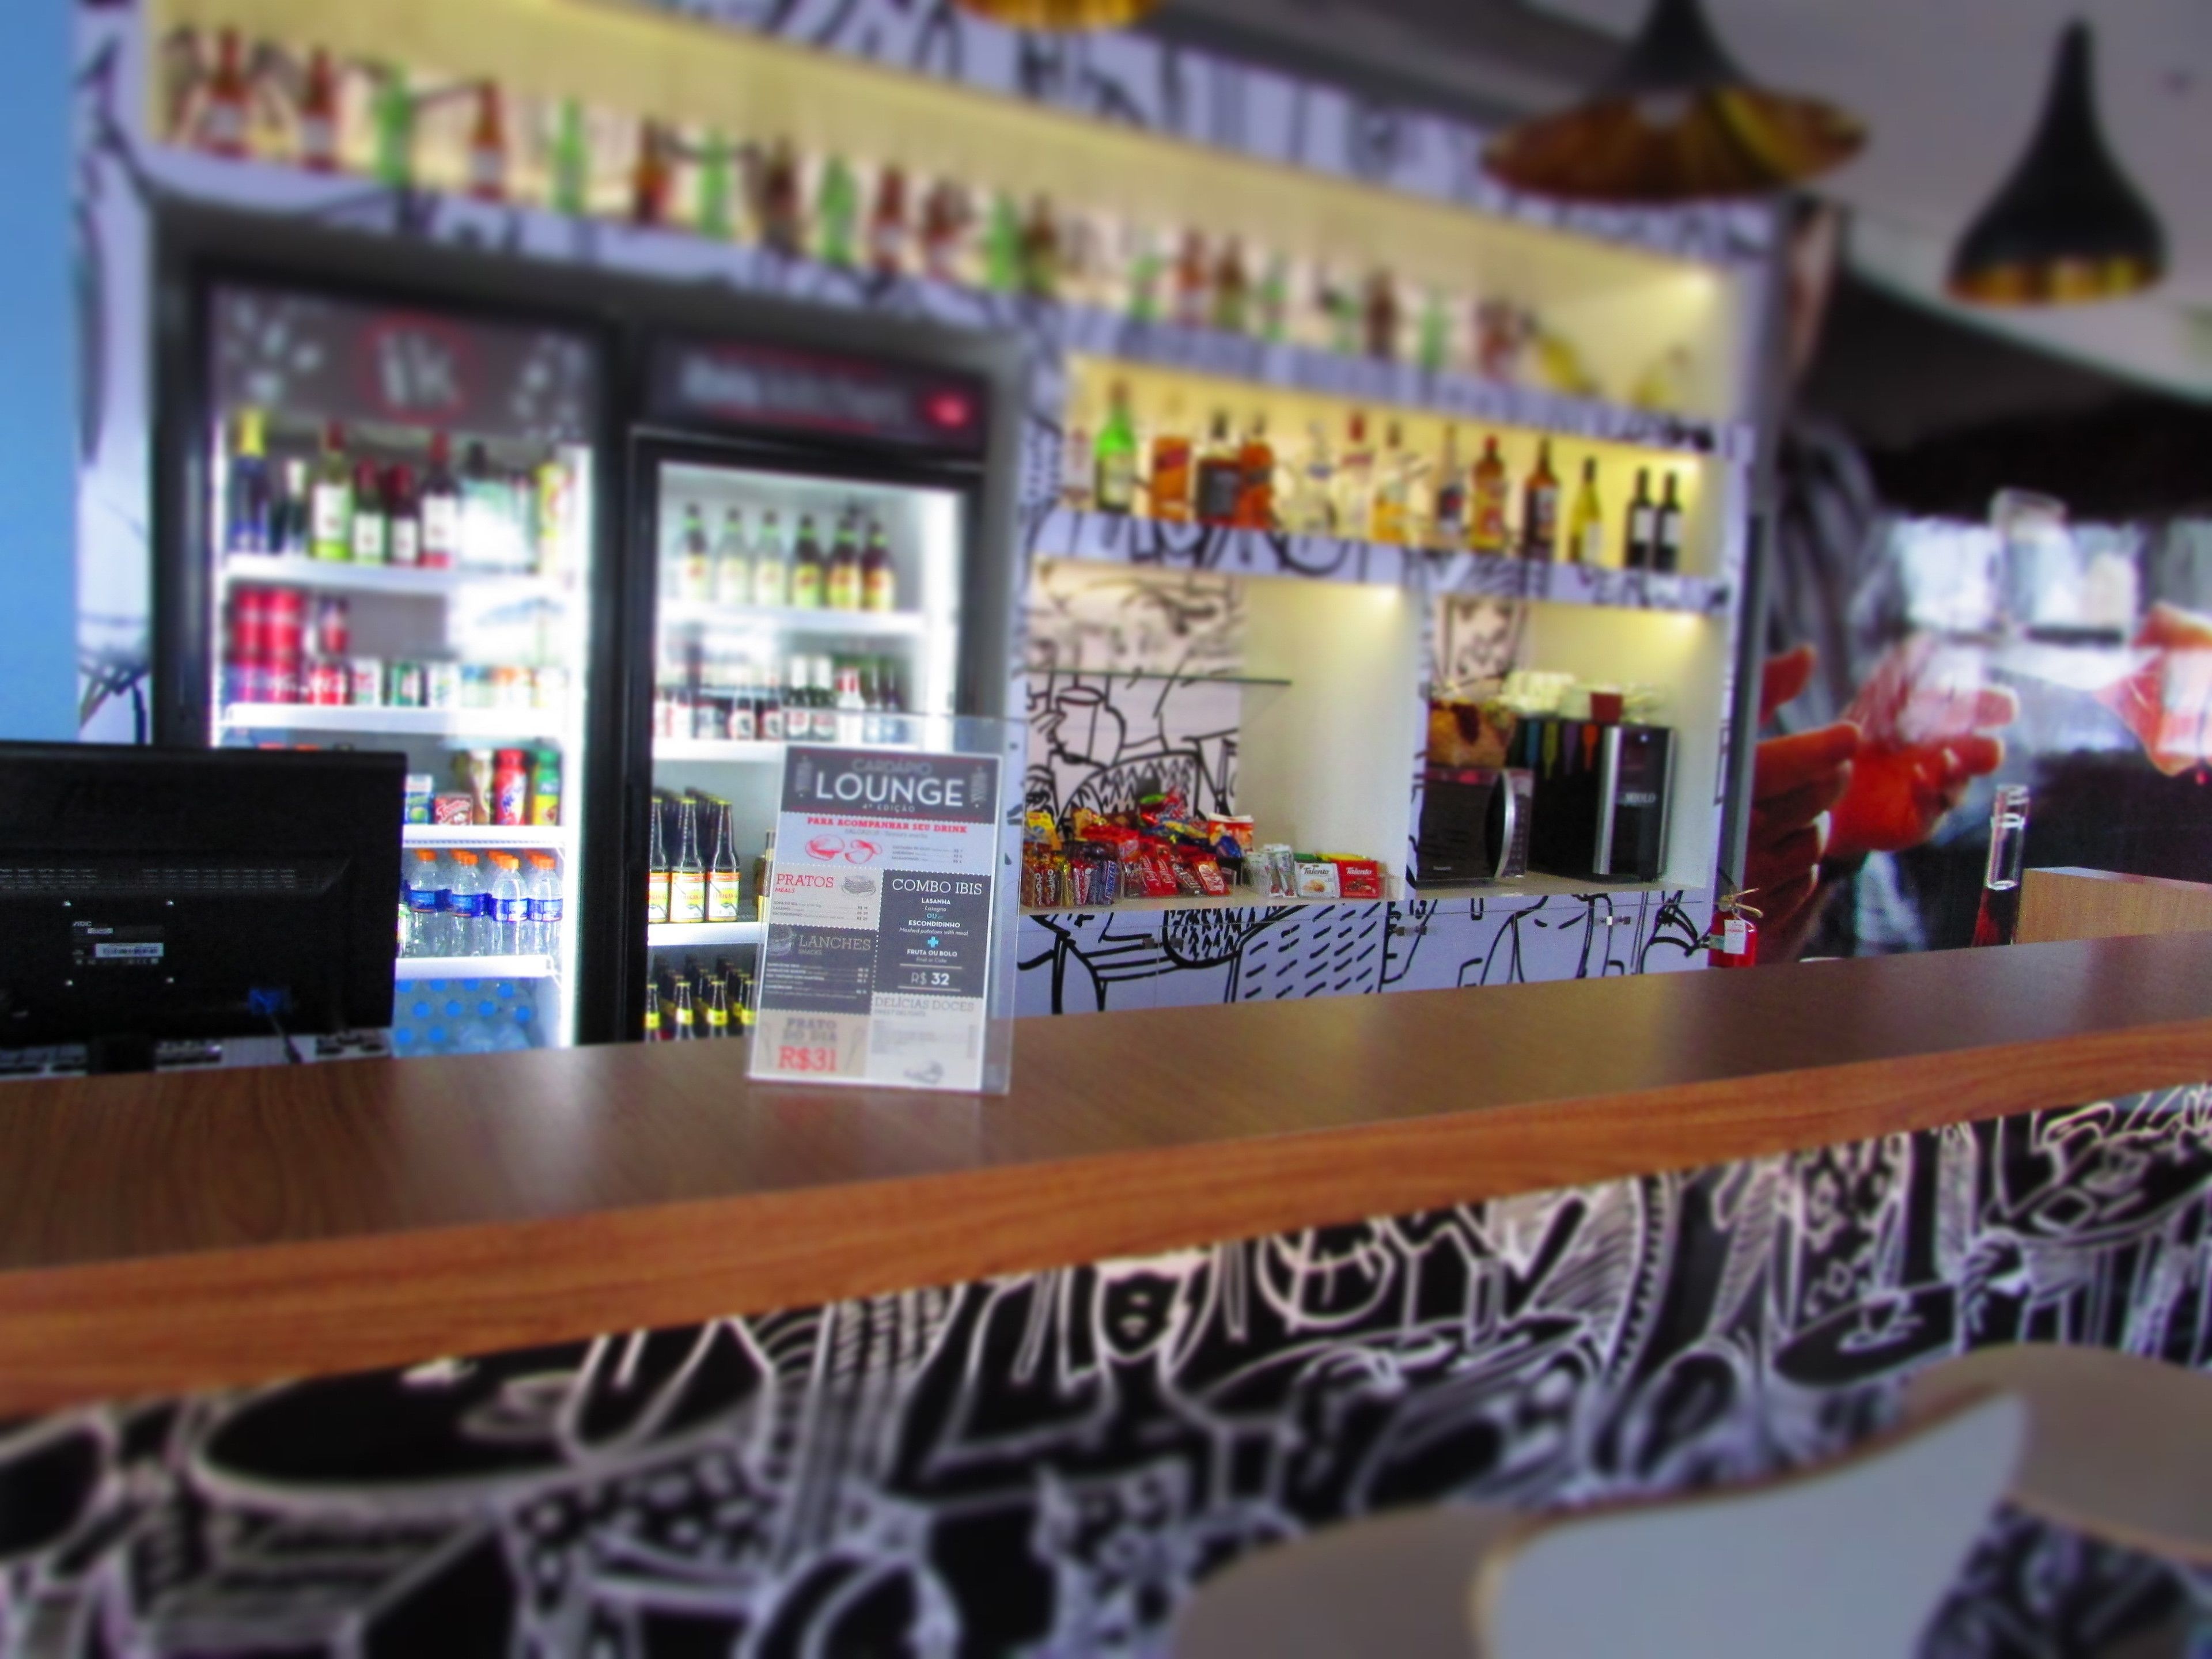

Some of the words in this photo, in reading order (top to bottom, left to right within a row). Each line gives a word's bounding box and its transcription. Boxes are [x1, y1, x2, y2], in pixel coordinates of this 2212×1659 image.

[816, 771, 964, 807] LOUNGE
[877, 803, 915, 813] EDIÇÃO
[807, 817, 834, 825] PARA
[837, 819, 909, 831] ACOMPANHAR
[912, 822, 930, 831] SEU
[934, 824, 967, 834] DRINK
[1303, 867, 1330, 875] Talento
[1346, 866, 1373, 875] Talento
[777, 873, 834, 888] PRATOS
[892, 878, 951, 893] COMBO
[955, 881, 983, 895] IBIS
[908, 920, 960, 928] ESCONDIDINHO
[799, 935, 871, 950] LANCHES
[911, 972, 927, 986] R$
[931, 972, 950, 986] 32
[874, 997, 930, 1010] DELÍCIAS
[931, 1000, 975, 1012] DOCES
[778, 1045, 837, 1072] R$31
